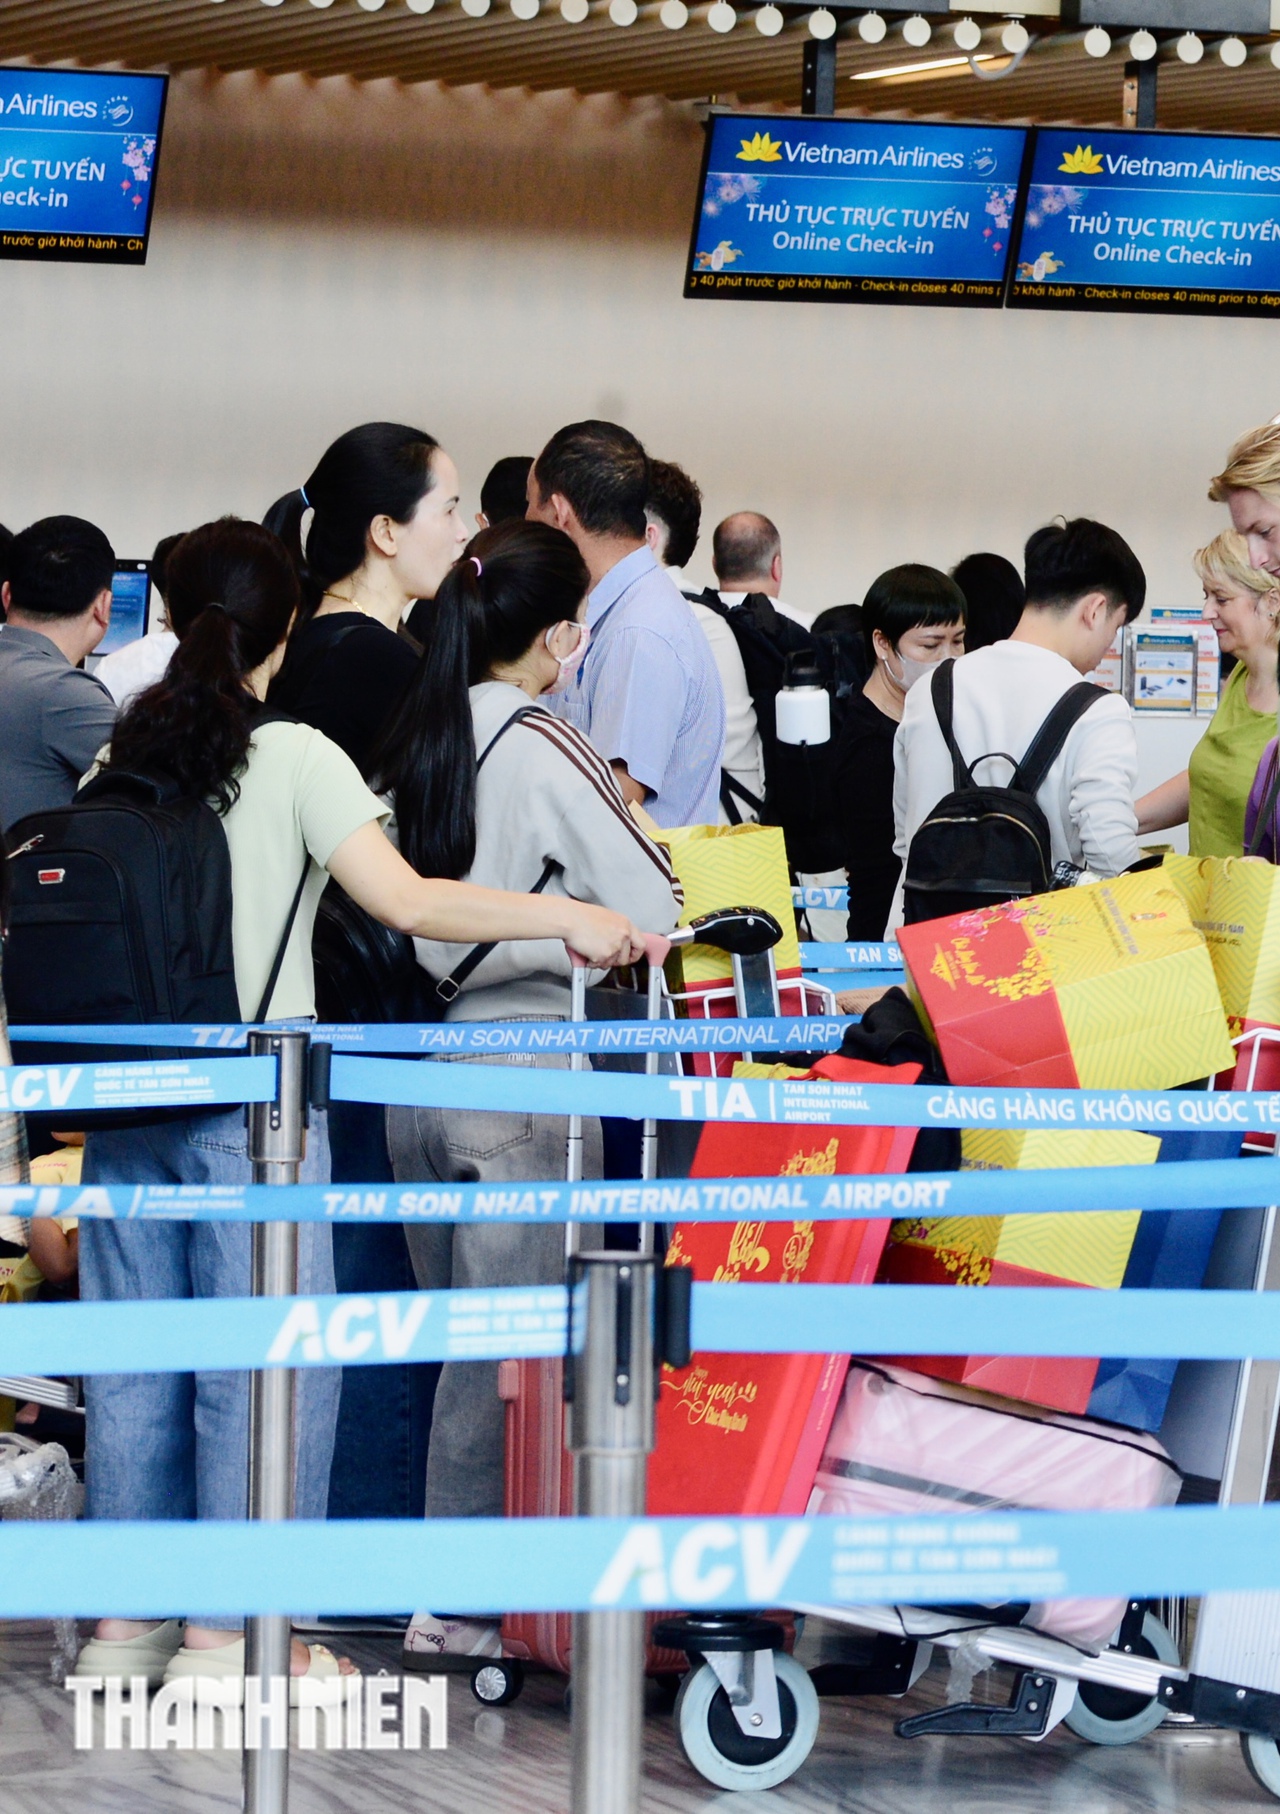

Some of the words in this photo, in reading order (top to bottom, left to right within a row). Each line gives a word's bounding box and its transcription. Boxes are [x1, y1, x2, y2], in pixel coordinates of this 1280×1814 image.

[31, 156, 106, 182] TUYẾN
[0, 187, 68, 207] eck-in
[747, 200, 790, 223] THỦ
[795, 205, 837, 229] TỤC
[841, 206, 898, 231] TRỰC
[901, 206, 969, 229] TUYẾN
[1068, 211, 1111, 235] THỦ
[1115, 217, 1157, 240] TỤC
[1160, 218, 1216, 242] TRỰC
[3, 235, 34, 247] trước
[38, 236, 56, 249] giờ
[60, 236, 84, 248] khởi
[88, 237, 117, 249] hành
[773, 231, 841, 251] Online
[846, 234, 934, 254] Check-in
[1094, 243, 1161, 263] Online
[1166, 246, 1252, 266] Check-in
[700, 276, 714, 287] 40
[717, 275, 742, 289] phút
[745, 276, 775, 288] trước
[777, 277, 795, 291] giờ
[798, 276, 822, 289] khởi
[825, 278, 852, 290] hành
[861, 280, 909, 292] Check-in
[911, 282, 947, 294] closes
[950, 283, 964, 293] 40
[967, 284, 993, 295] mins
[1022, 284, 1045, 297] khởi
[1048, 286, 1075, 298] hành
[1084, 287, 1131, 300] Check-in
[1134, 289, 1170, 301] closes
[1173, 291, 1188, 301] 40
[1190, 292, 1216, 303] mins
[1219, 294, 1244, 305] prior
[1247, 295, 1258, 304] to
[846, 947, 882, 963] TAN
[418, 1029, 466, 1047] TAN
[469, 1029, 522, 1047] SON
[527, 1028, 593, 1046] NHAT
[598, 1025, 779, 1046] INTERNATIONAL
[785, 1023, 849, 1044] AIRPO
[0, 1068, 82, 1108] CV
[669, 1080, 756, 1119] TIA
[783, 1084, 805, 1095] TAN
[808, 1085, 830, 1096] SON
[833, 1085, 863, 1096] NHAT
[783, 1098, 870, 1111] INTERNATIONAL
[927, 1090, 996, 1120] CẢNG
[1004, 1092, 1075, 1122] HÀNG
[1083, 1093, 1172, 1122] KHÔNG
[1178, 1093, 1248, 1126] QUỐC
[1253, 1087, 1280, 1123] TẾ
[784, 1111, 831, 1122] AIRPORT
[324, 1193, 387, 1216] TAN
[397, 1192, 461, 1216] SON
[473, 1190, 560, 1215] NHAT
[569, 1184, 808, 1215] INTERNATIONAL
[820, 1180, 951, 1210] AIRPORT
[266, 1296, 433, 1362] ACV
[591, 1521, 813, 1604] ACV
